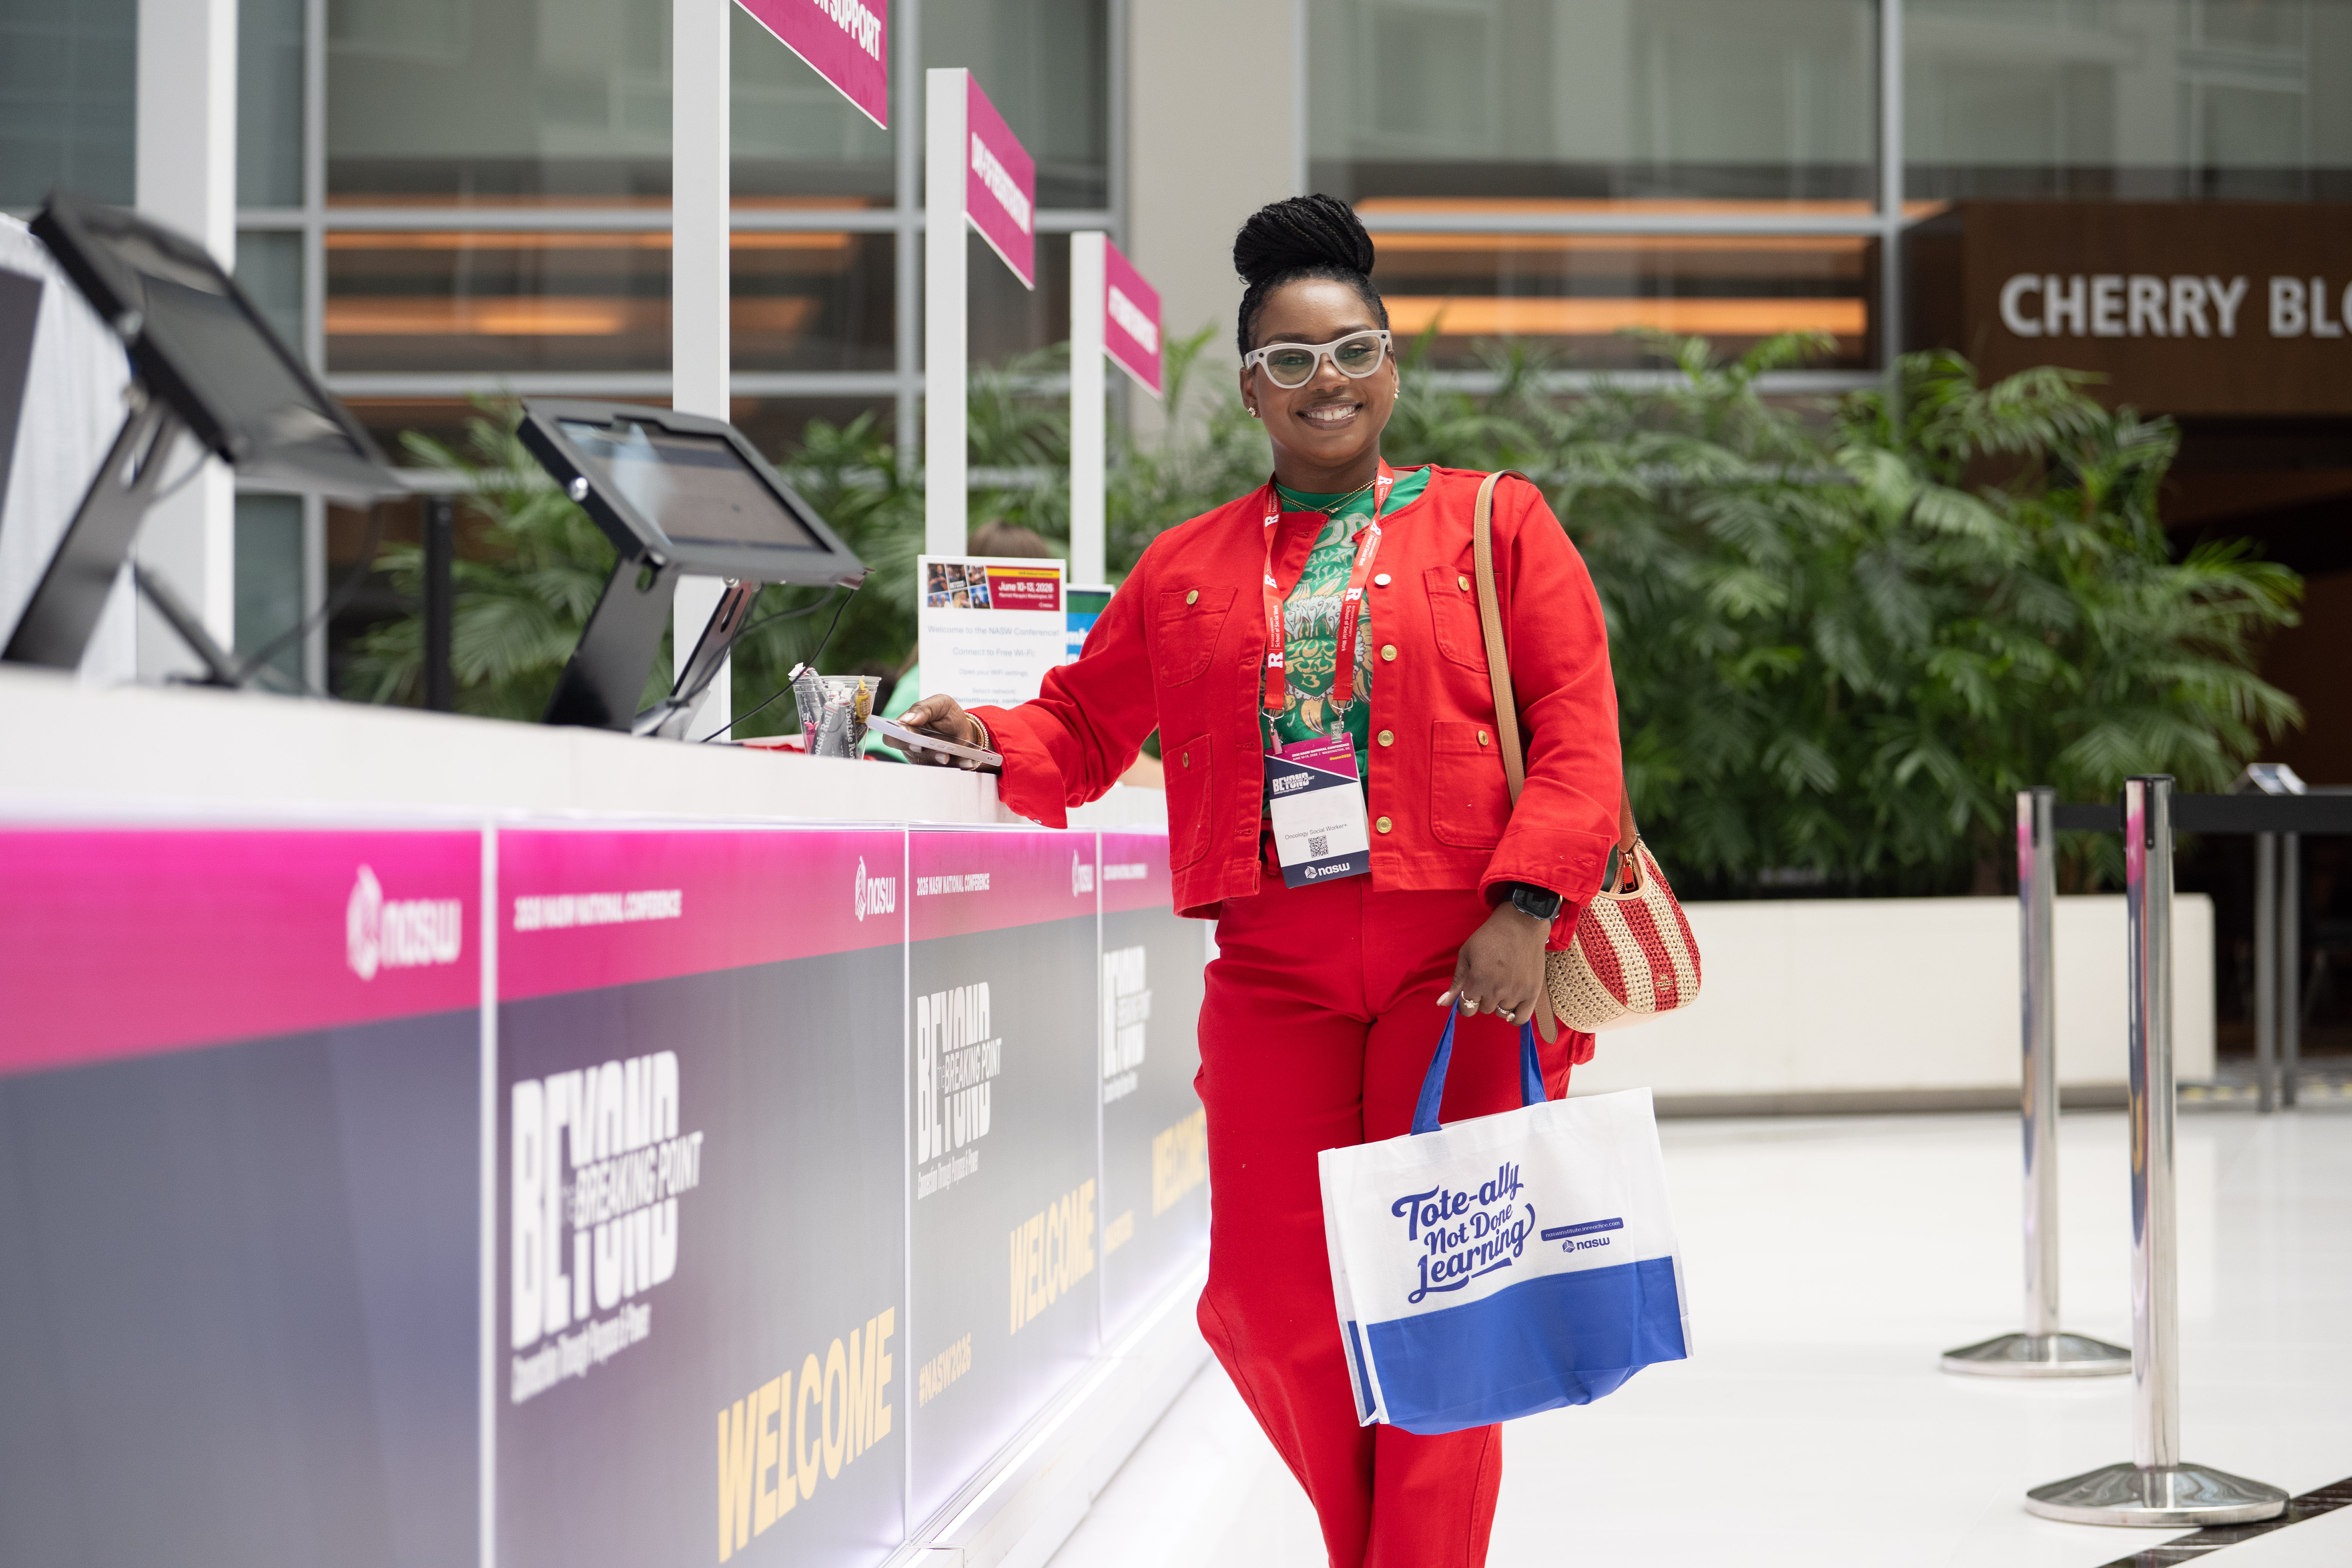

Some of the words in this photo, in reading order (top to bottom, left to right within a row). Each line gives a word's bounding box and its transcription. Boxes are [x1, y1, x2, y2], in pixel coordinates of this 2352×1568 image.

[1999, 273, 2249, 337] CHERRY
[2268, 275, 2352, 338] BL
[1377, 475, 1393, 485] R
[1265, 514, 1279, 527] R
[1370, 520, 1381, 536] R
[998, 581, 1017, 591] June
[1016, 582, 1036, 593] 10-13,
[1265, 574, 1277, 588] R
[1345, 588, 1363, 602] R
[928, 625, 964, 634] Welcome
[1013, 628, 1059, 637] Conference!
[953, 648, 985, 656] Connect
[996, 648, 1012, 657] Free
[1013, 649, 1035, 657] Wi-Fi:
[1268, 652, 1283, 668] R
[820, 711, 833, 732] Roll
[846, 705, 855, 742] Tootsie
[1272, 772, 1309, 792] BEYOND
[1285, 776, 1304, 785] BREAKING
[1318, 862, 1350, 876] nasw
[917, 877, 928, 896] 2026
[929, 876, 943, 895] NASW
[943, 875, 964, 894] NATIONAL
[964, 873, 990, 892] CONFERENCE
[867, 877, 895, 915] nasw
[917, 982, 990, 1165] BEYOND
[944, 1044, 980, 1094] BREAKING
[981, 1038, 1002, 1081] POINT
[574, 1143, 658, 1230] BREAKING
[657, 1130, 703, 1201] POINT
[511, 1050, 679, 1350] BEYOND
[1391, 1161, 1524, 1241] Tote-ally
[1424, 1222, 1470, 1255] Not
[1469, 1204, 1513, 1239] Done
[1546, 1220, 1620, 1238] naswinstitute.inreachce.com
[1408, 1203, 1535, 1304] Learning
[1576, 1237, 1610, 1250] nasw
[1010, 1178, 1095, 1336] WELCOME
[919, 1332, 971, 1409] #NASW2026
[718, 1306, 895, 1564] WELCOME
